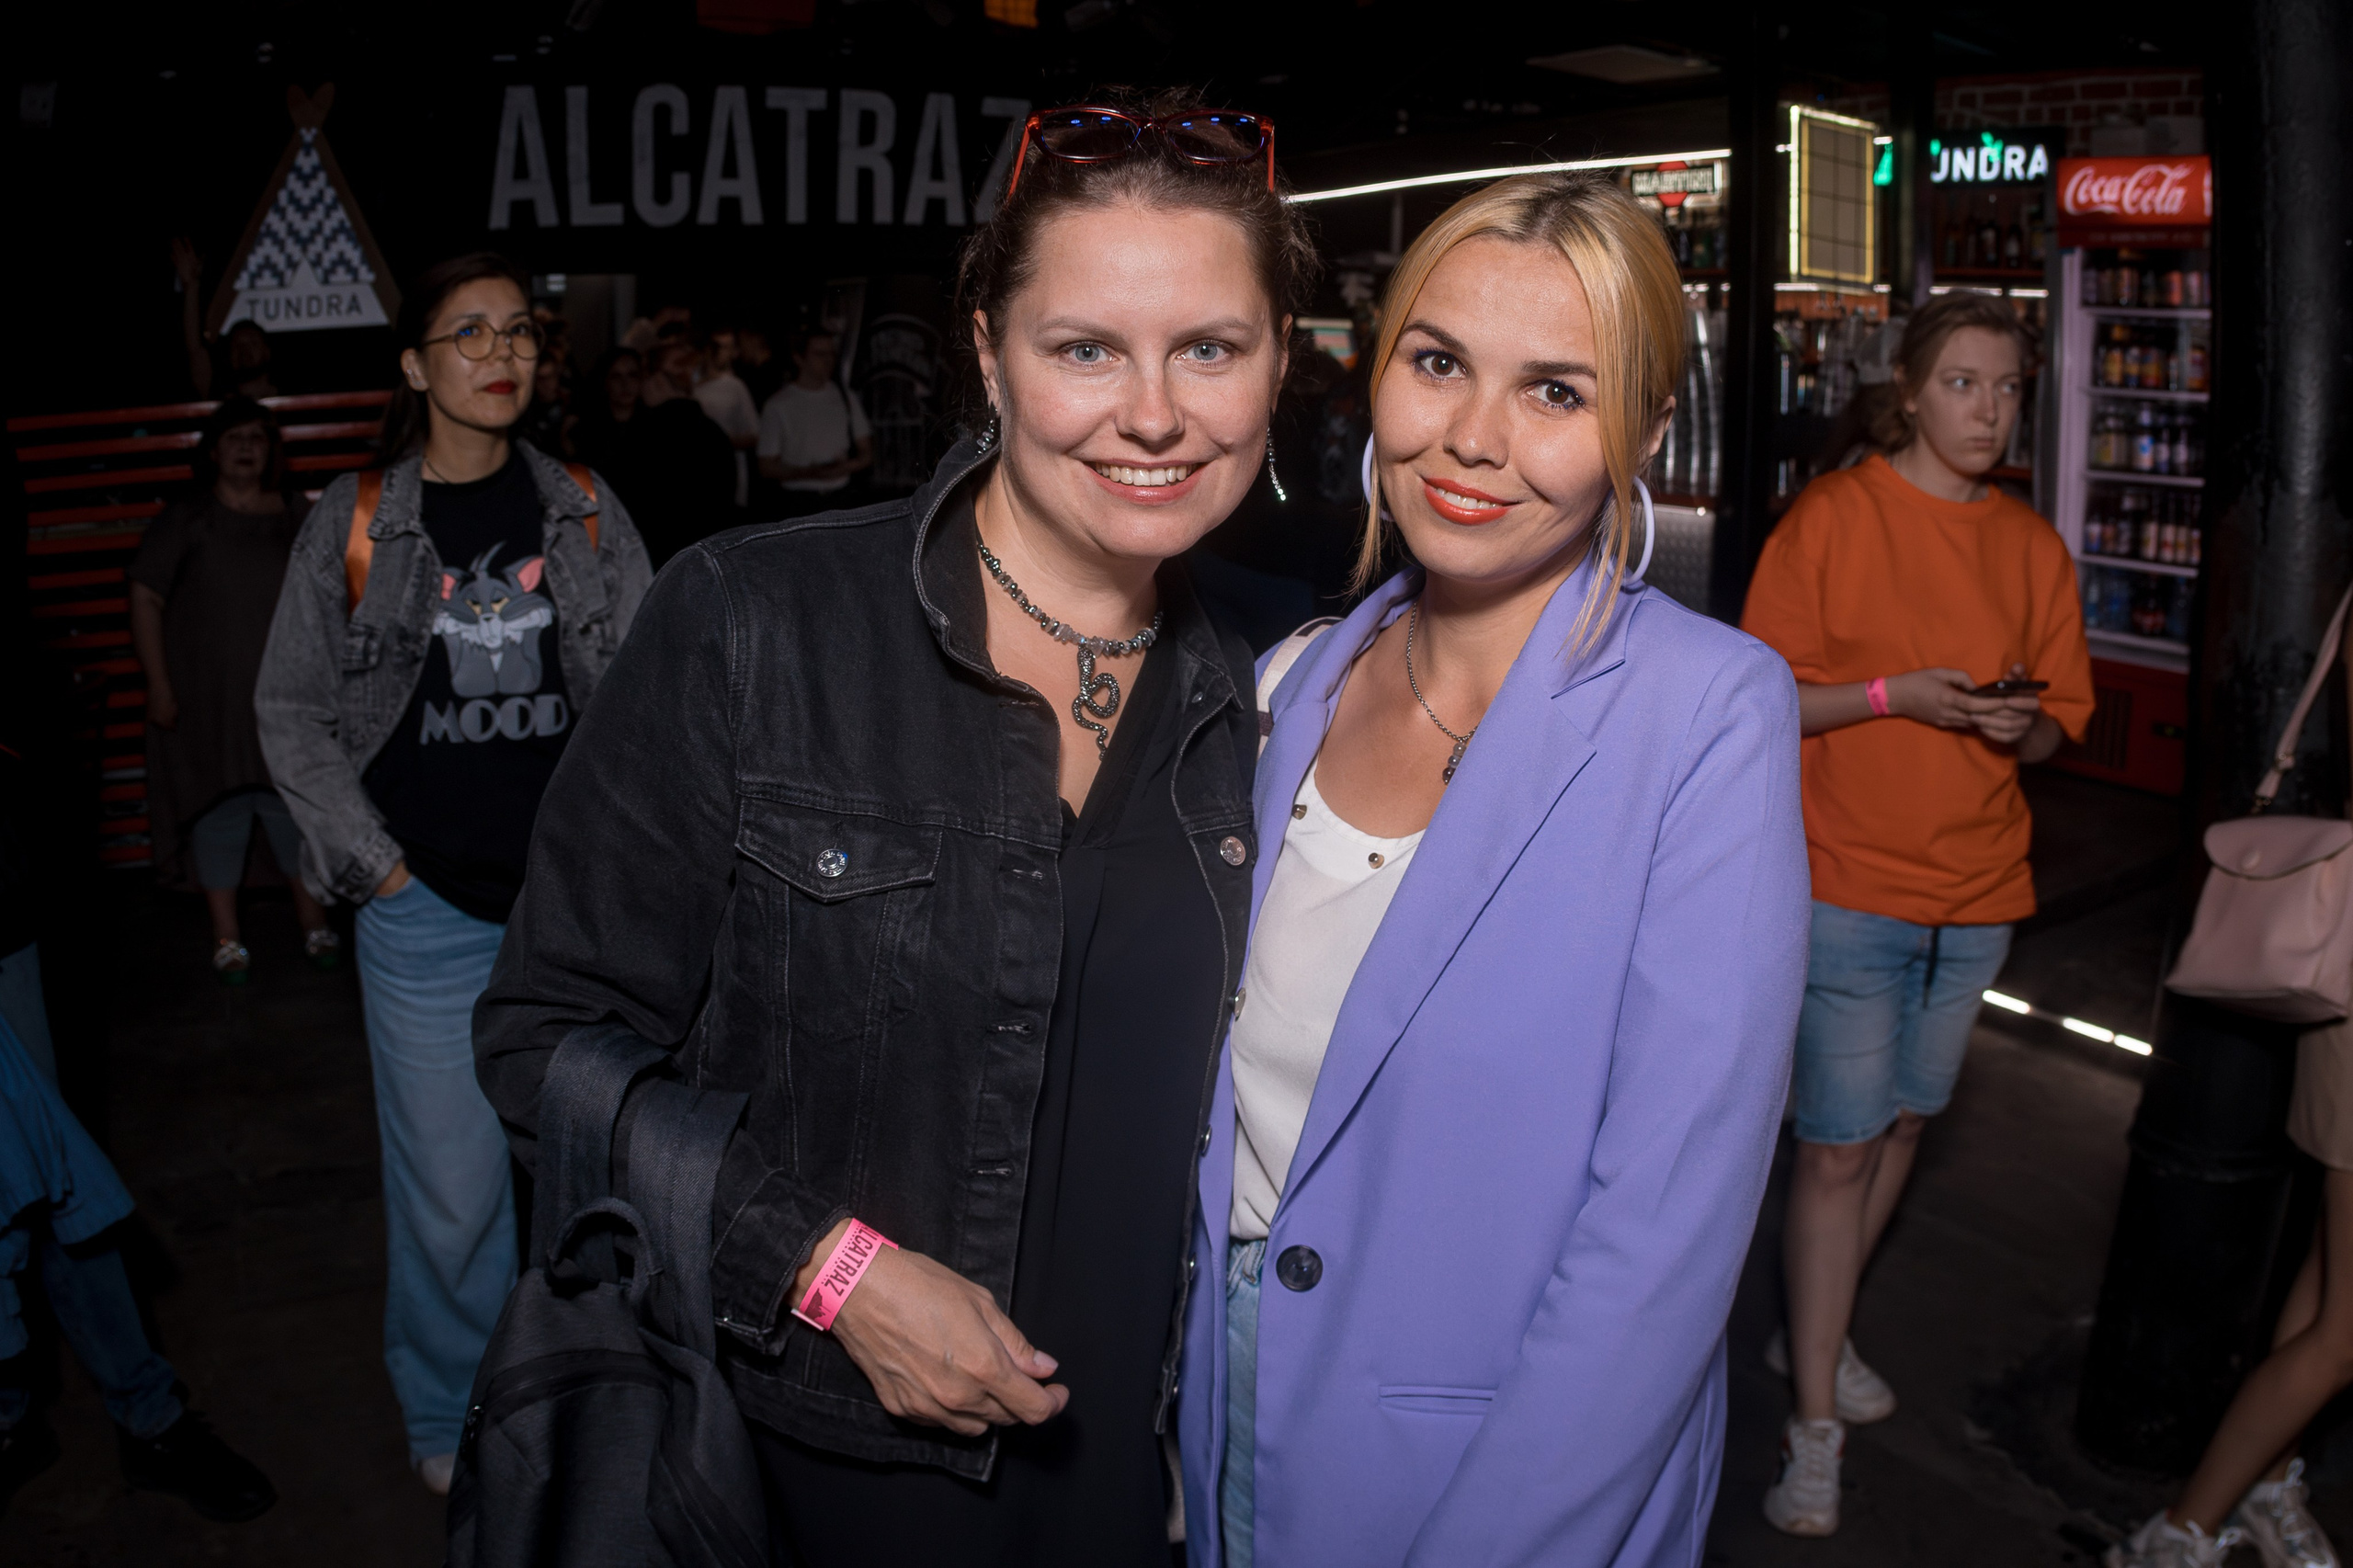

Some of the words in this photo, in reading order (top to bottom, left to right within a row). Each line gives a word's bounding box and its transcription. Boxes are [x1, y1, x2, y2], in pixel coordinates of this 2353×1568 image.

[487, 83, 1033, 231] ALCATRAZ
[1929, 143, 2049, 183] UNDRA
[246, 291, 363, 322] TUNDRA
[419, 693, 569, 746] MOOD
